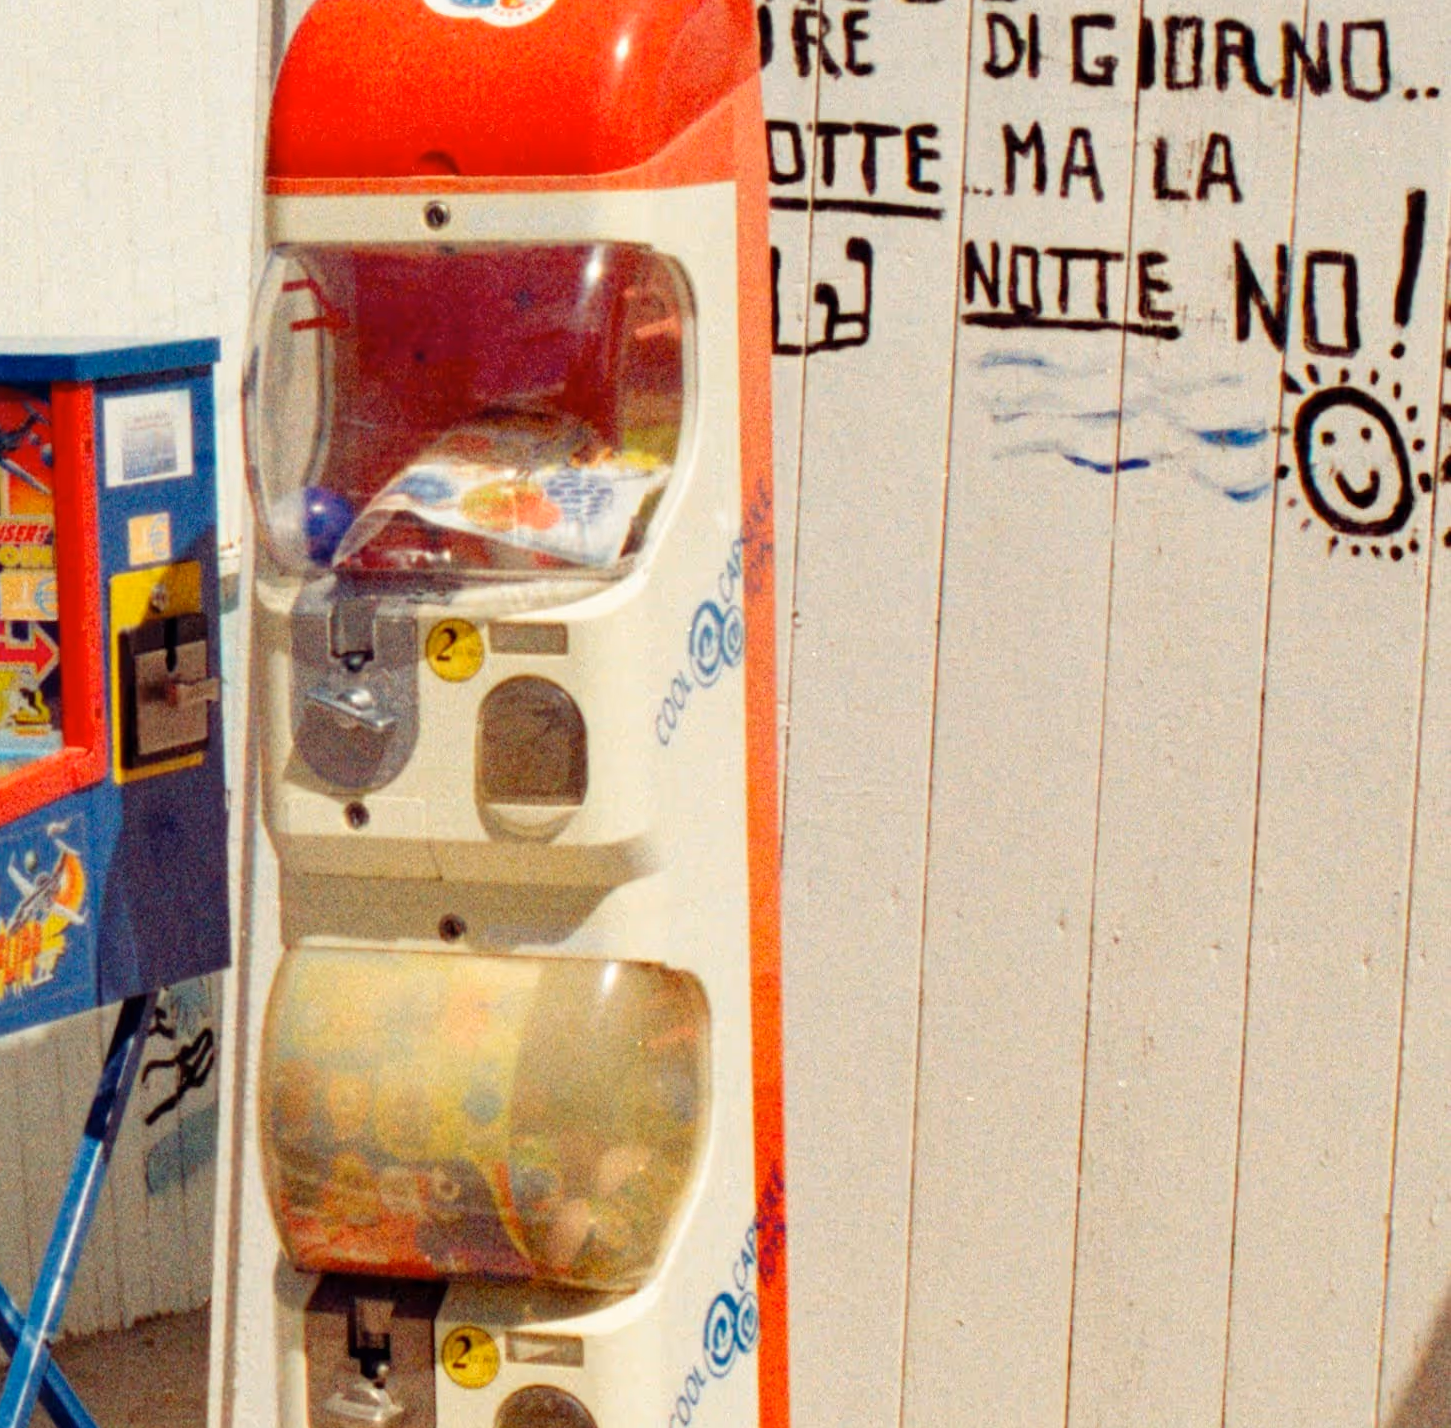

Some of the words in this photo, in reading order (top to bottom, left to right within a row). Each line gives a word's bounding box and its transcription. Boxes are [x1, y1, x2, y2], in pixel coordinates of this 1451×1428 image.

[984, 13, 1040, 78] DI
[765, 120, 942, 197] OTTE
[1154, 131, 1243, 204] LA
[963, 240, 1175, 321] NOTTE
[436, 628, 457, 662] 2
[655, 669, 694, 747] COOL
[452, 1335, 472, 1369] 2
